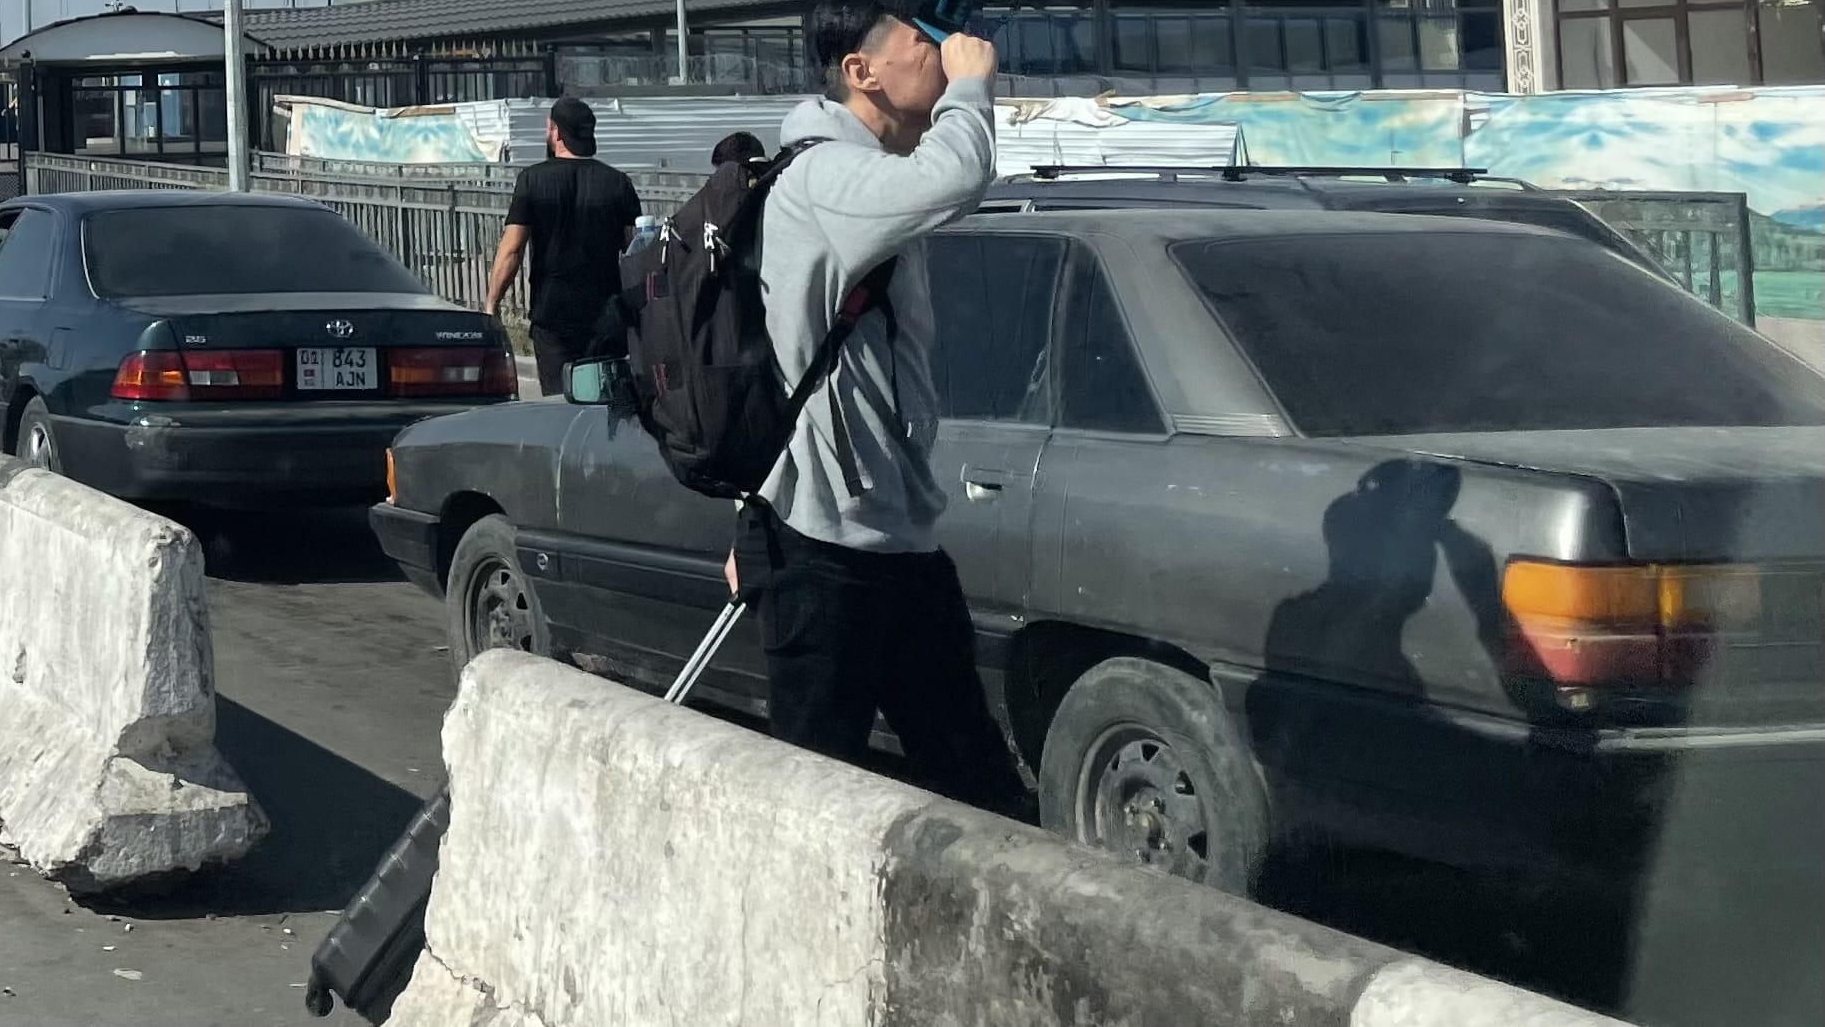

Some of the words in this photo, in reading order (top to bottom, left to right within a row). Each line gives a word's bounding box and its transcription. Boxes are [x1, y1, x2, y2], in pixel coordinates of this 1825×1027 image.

[301, 349, 319, 365] 01
[333, 349, 367, 368] 843
[336, 371, 367, 387] AJN
